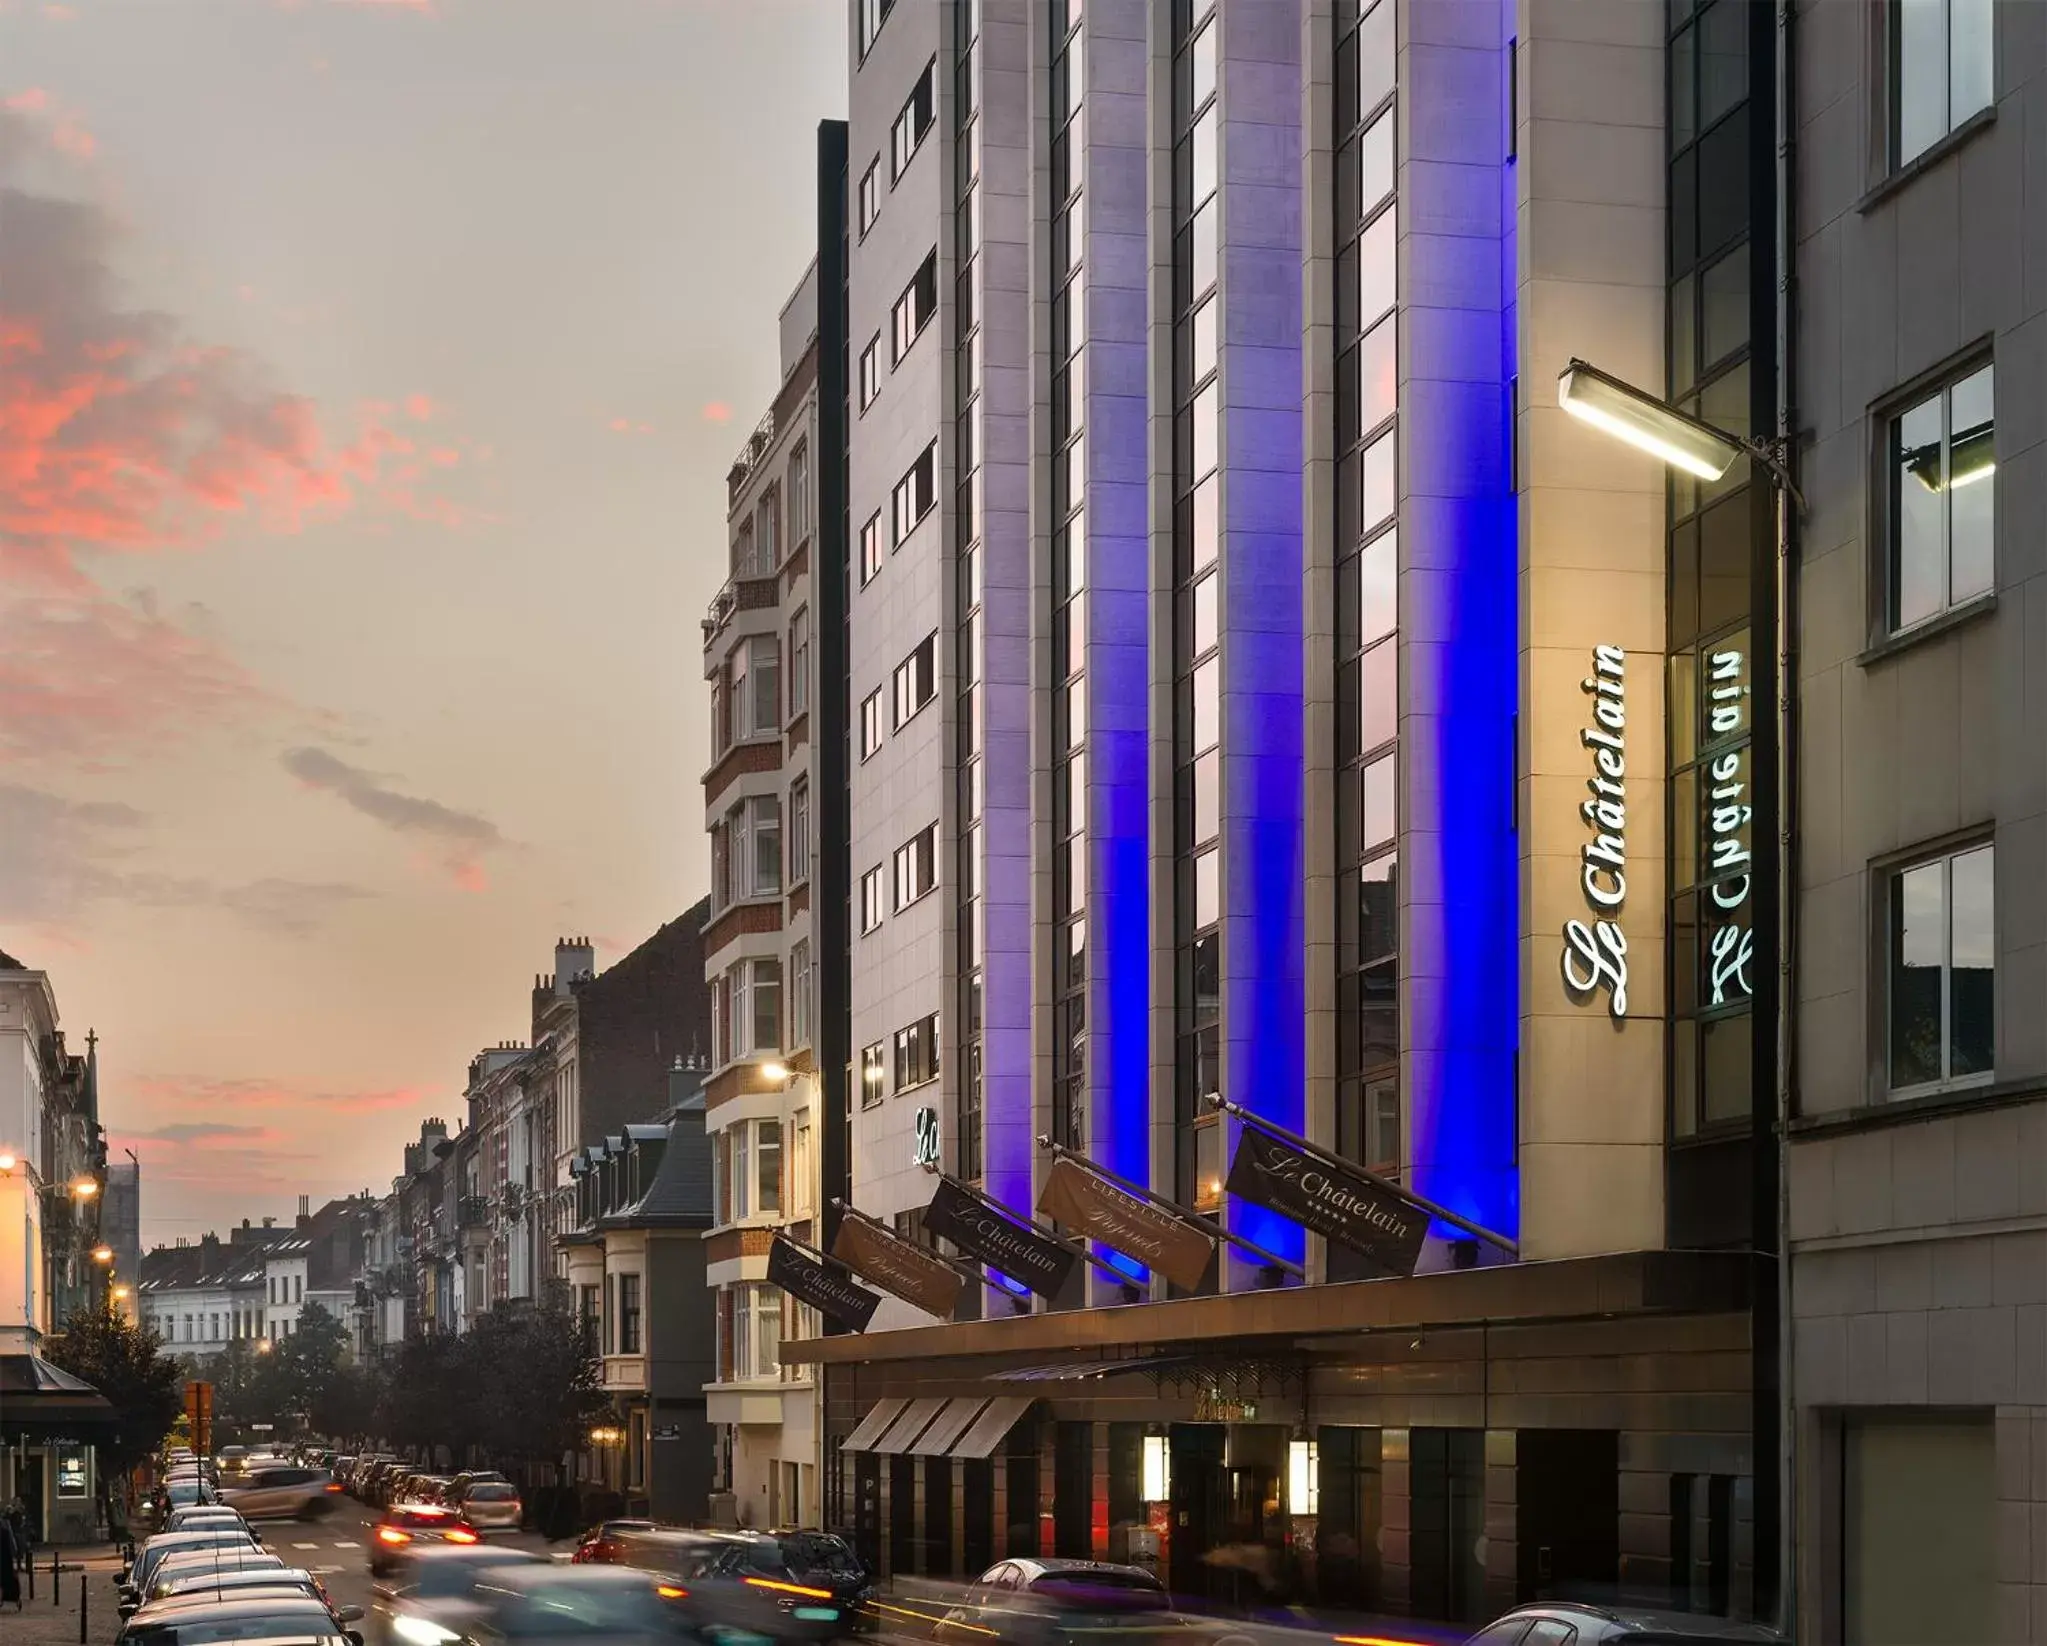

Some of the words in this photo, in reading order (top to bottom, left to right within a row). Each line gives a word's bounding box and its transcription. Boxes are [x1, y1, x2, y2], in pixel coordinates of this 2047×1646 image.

[1584, 644, 1626, 905] Châtelain
[1564, 919, 1627, 1016] Le
[1091, 1179, 1180, 1233] LIFESTYLE
[1253, 1147, 1302, 1183] Le
[1300, 1172, 1409, 1239] Châtelain
[977, 1219, 1058, 1273] Châtelain
